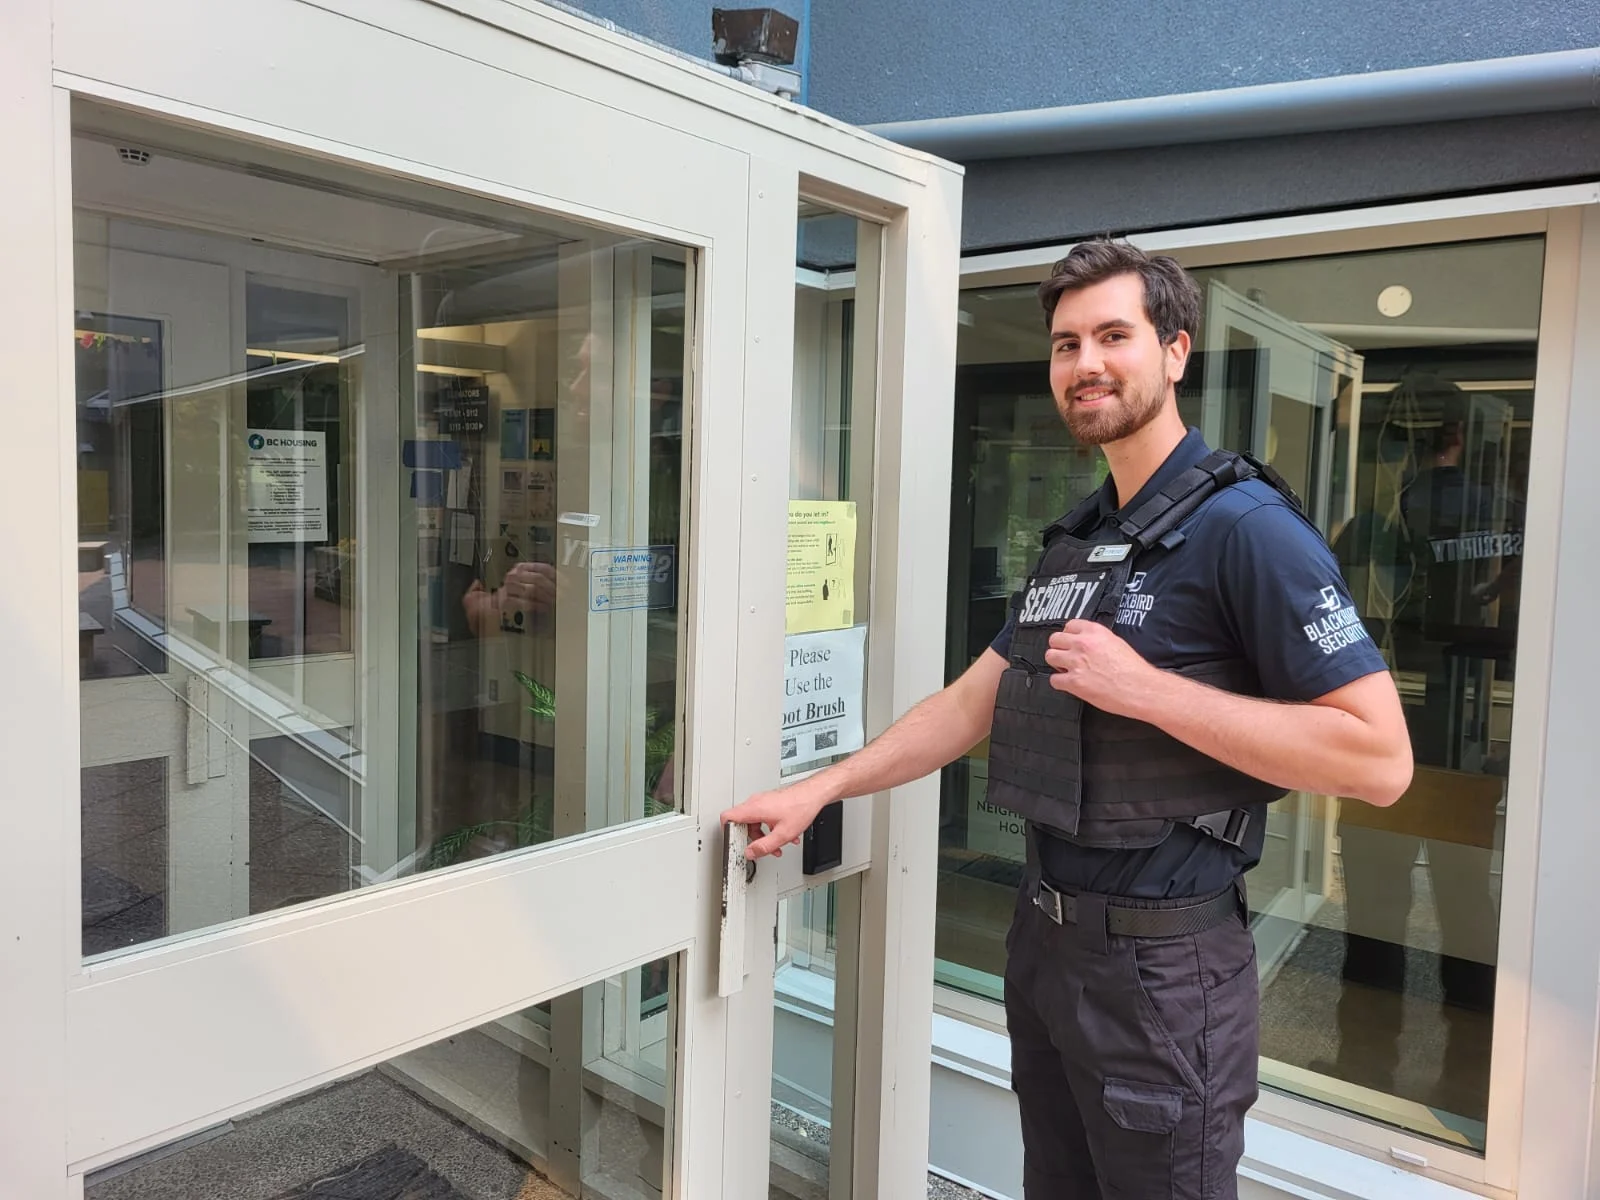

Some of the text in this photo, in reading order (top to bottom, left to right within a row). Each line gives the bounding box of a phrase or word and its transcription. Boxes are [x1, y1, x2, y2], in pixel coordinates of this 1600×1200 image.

[266, 438, 318, 448] BC HOUSING
[803, 511, 813, 519] you
[613, 554, 652, 563] WARNING
[1019, 581, 1100, 624] SECURITY
[1119, 593, 1155, 612] CKBIRD
[1116, 607, 1148, 627] URITY
[1318, 622, 1369, 655] SECURITY
[790, 648, 831, 667] Please
[785, 672, 833, 697] Use the
[782, 696, 846, 726] oot Brush
[1000, 821, 1026, 836] HOU
